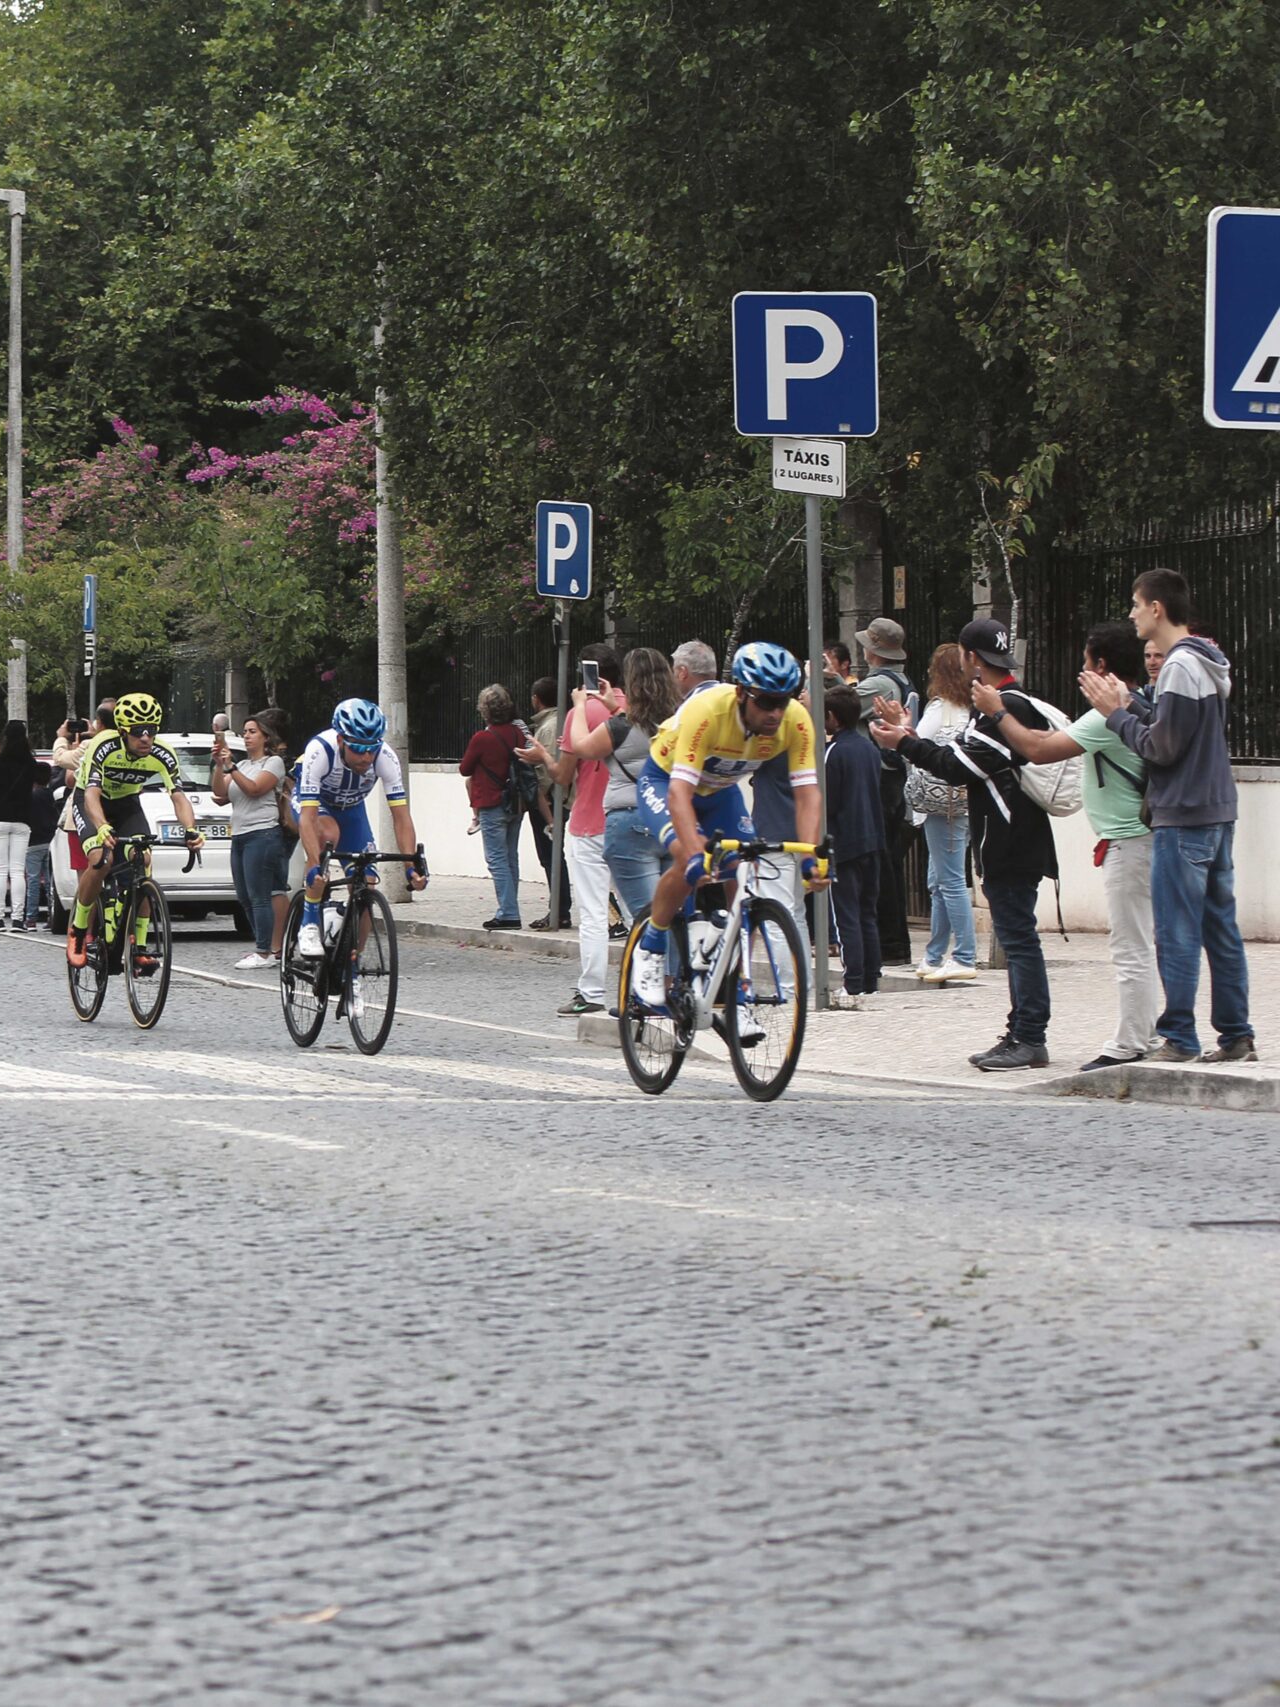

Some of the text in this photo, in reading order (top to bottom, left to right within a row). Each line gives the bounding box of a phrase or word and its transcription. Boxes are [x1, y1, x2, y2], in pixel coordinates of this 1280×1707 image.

[765, 308, 844, 420] P
[547, 511, 578, 586] P
[95, 740, 118, 763] EFAPEL
